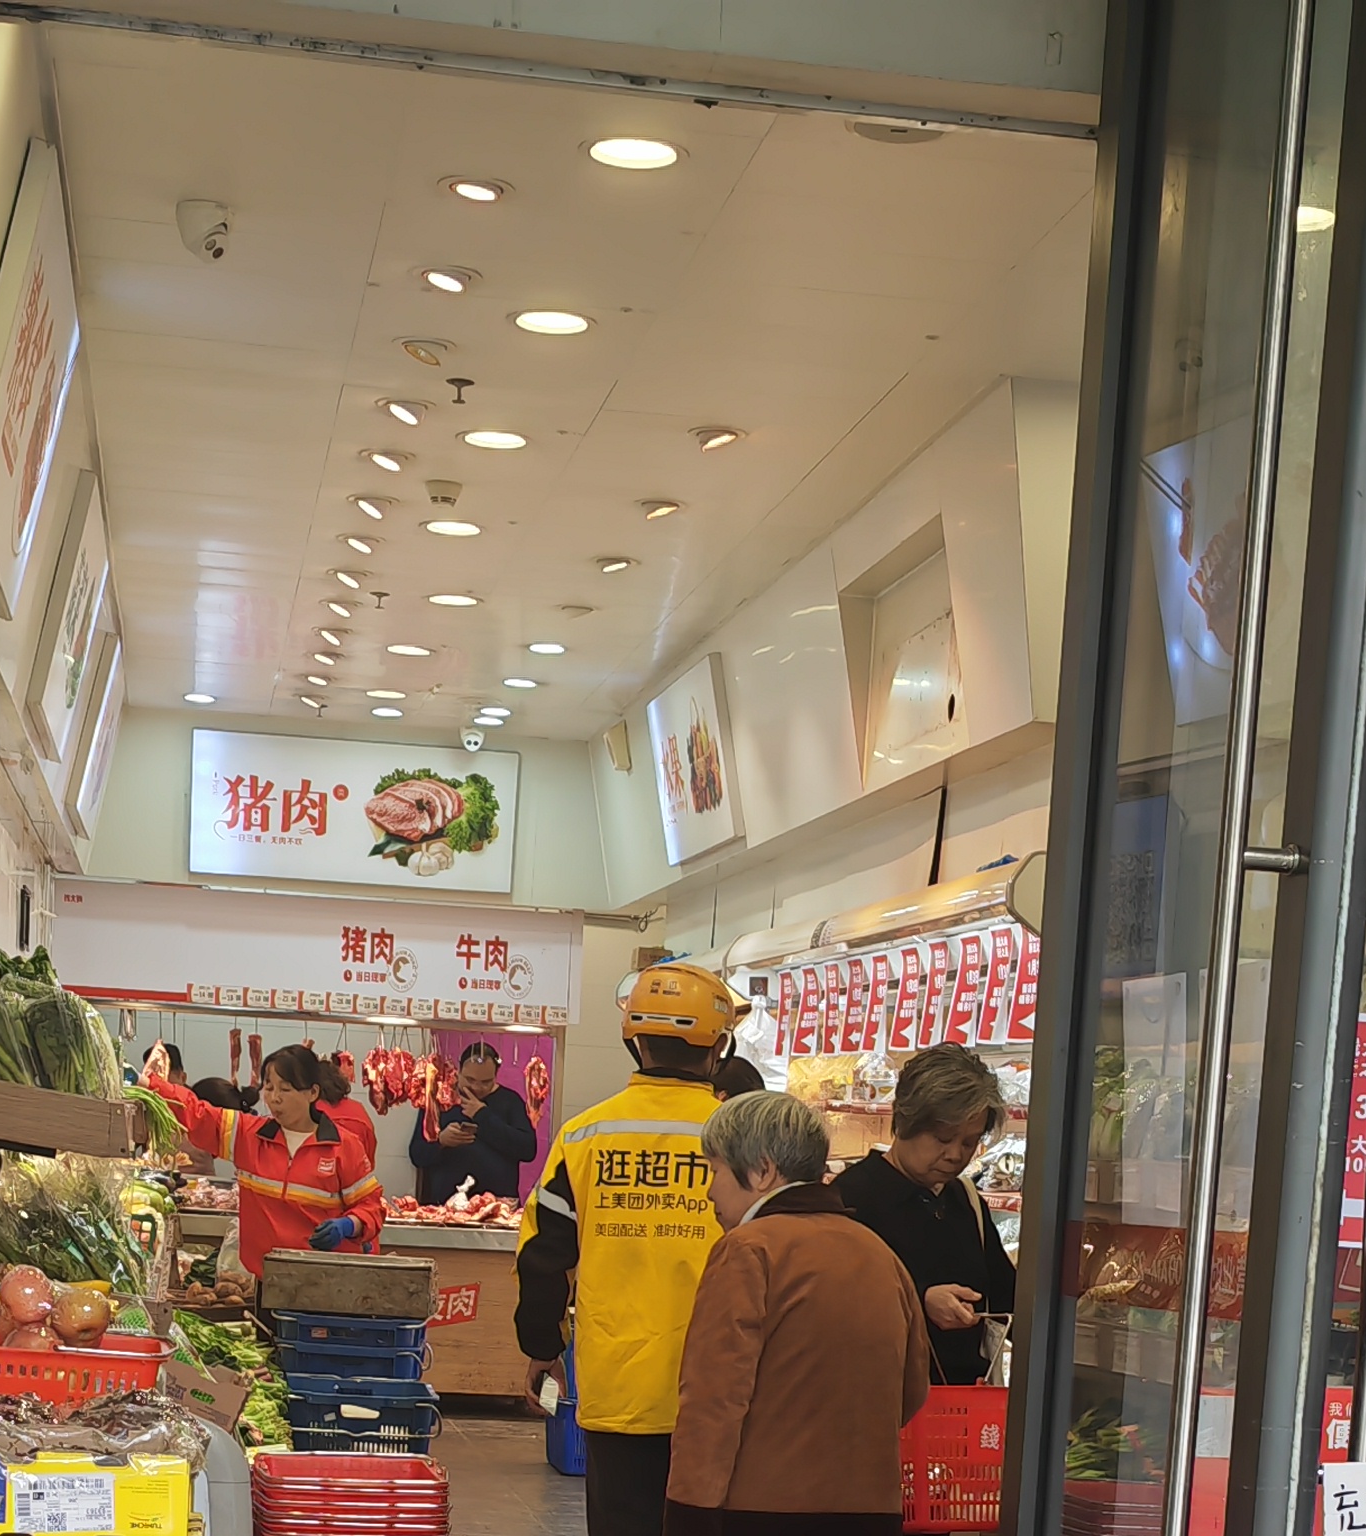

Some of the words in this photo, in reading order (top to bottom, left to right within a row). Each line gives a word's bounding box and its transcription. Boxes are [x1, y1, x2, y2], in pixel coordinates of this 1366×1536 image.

[222, 774, 328, 837] 猪肉
[341, 925, 394, 966] 猪肉
[455, 932, 509, 973] 牛肉
[594, 1148, 712, 1190] 逛超市
[593, 1191, 709, 1215] 上美团外卖App
[594, 1221, 648, 1238] 美团配送
[653, 1222, 706, 1240] 准时好用
